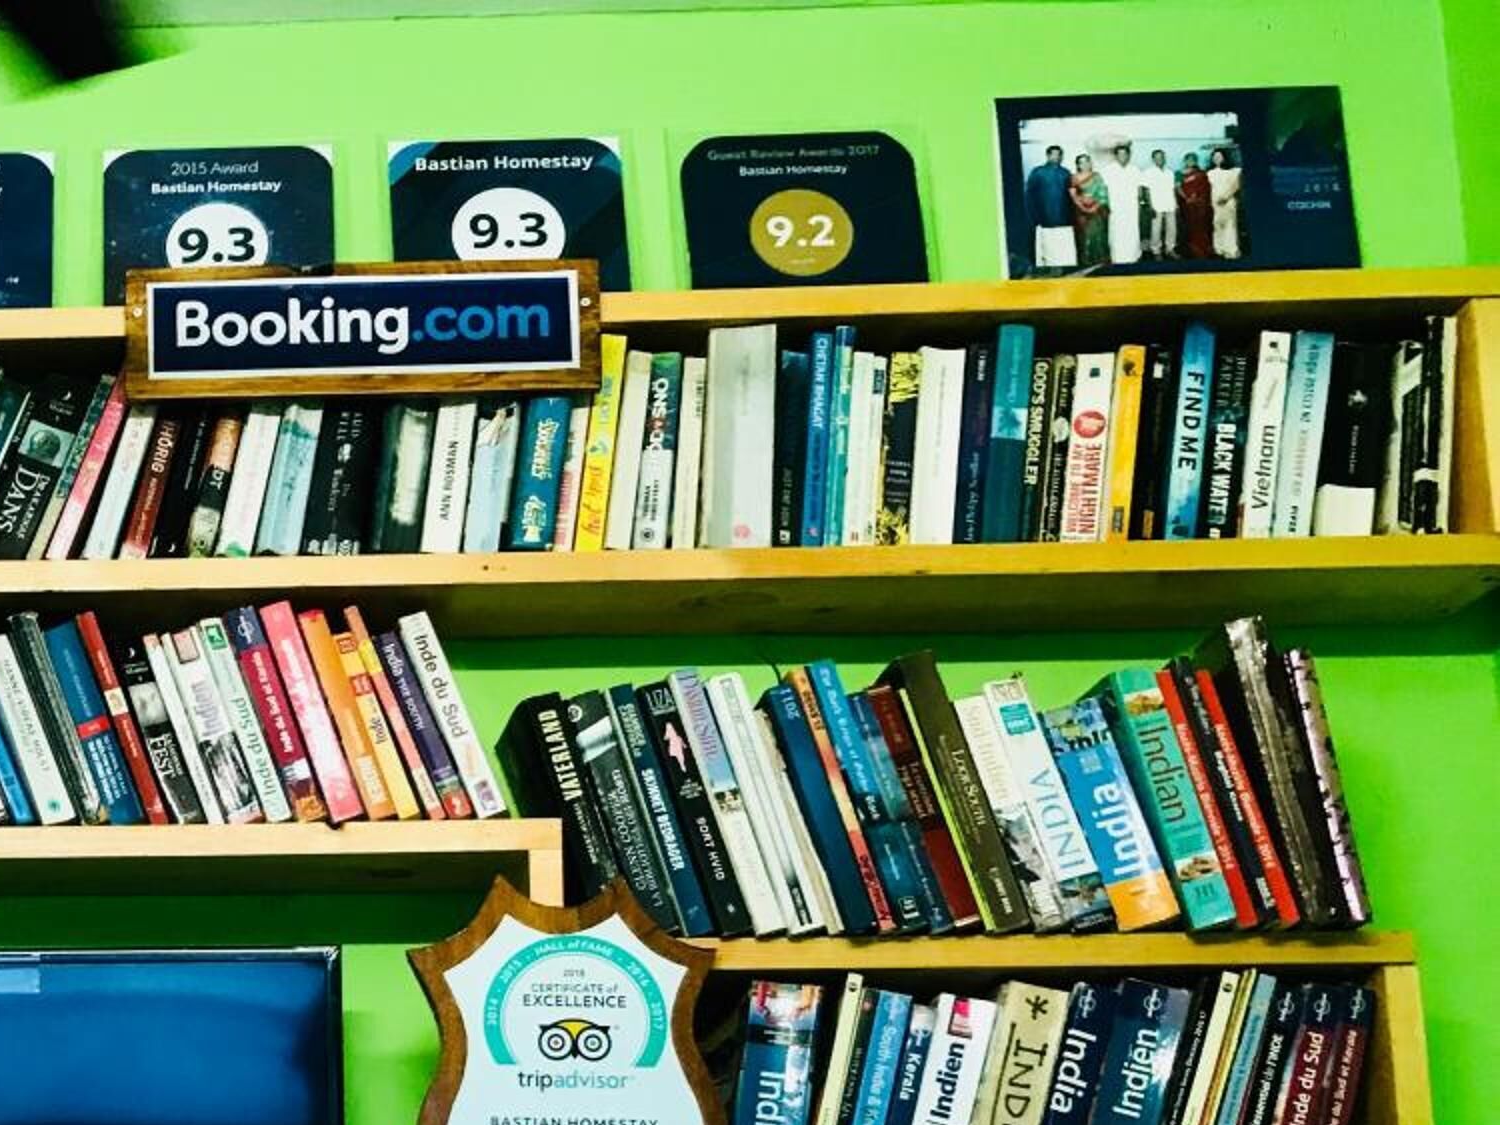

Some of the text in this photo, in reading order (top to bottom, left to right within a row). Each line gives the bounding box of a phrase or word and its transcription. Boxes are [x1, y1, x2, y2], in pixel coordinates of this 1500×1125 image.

[151, 179, 282, 194] Bastian Homestay
[170, 160, 259, 176] 2015 Award
[415, 154, 593, 171] Bastian Homestay
[739, 164, 848, 177] Bastian Homestay
[177, 227, 255, 264] 9.3
[469, 212, 548, 249] 9.3
[765, 214, 835, 248] 9.2
[175, 296, 550, 355] Booking.com
[813, 338, 828, 382] CHETAN
[811, 385, 827, 428] BHAGAT
[1024, 361, 1049, 485] GOD'S SMUGGLER
[1178, 371, 1205, 471] FIND ME
[1079, 442, 1102, 534] NIGHTMARE
[1208, 424, 1237, 525] BLACK WATER
[1252, 424, 1276, 510] Vietnam
[439, 491, 453, 520] ANN
[383, 642, 405, 677] India
[414, 634, 467, 738] Inde du Sud
[150, 737, 176, 778] FEST
[231, 697, 278, 796] Inde du Sud
[538, 709, 582, 801] VATERLAND
[1138, 724, 1187, 823] Indian
[657, 815, 684, 871] BEDRAGER
[1030, 768, 1086, 871] INDIA
[1092, 783, 1143, 877] India
[697, 817, 724, 880] SORT HVID
[522, 994, 627, 1009] EXCELLENCE
[531, 982, 618, 993] CERTIFICATE of
[1050, 1028, 1097, 1113] India
[1304, 1032, 1324, 1063] Sud
[518, 1070, 629, 1092] tripadvisor
[899, 1052, 921, 1101] Kerala
[930, 1042, 964, 1119] Indien
[1112, 1028, 1160, 1119] Indien
[1302, 1068, 1316, 1090] du
